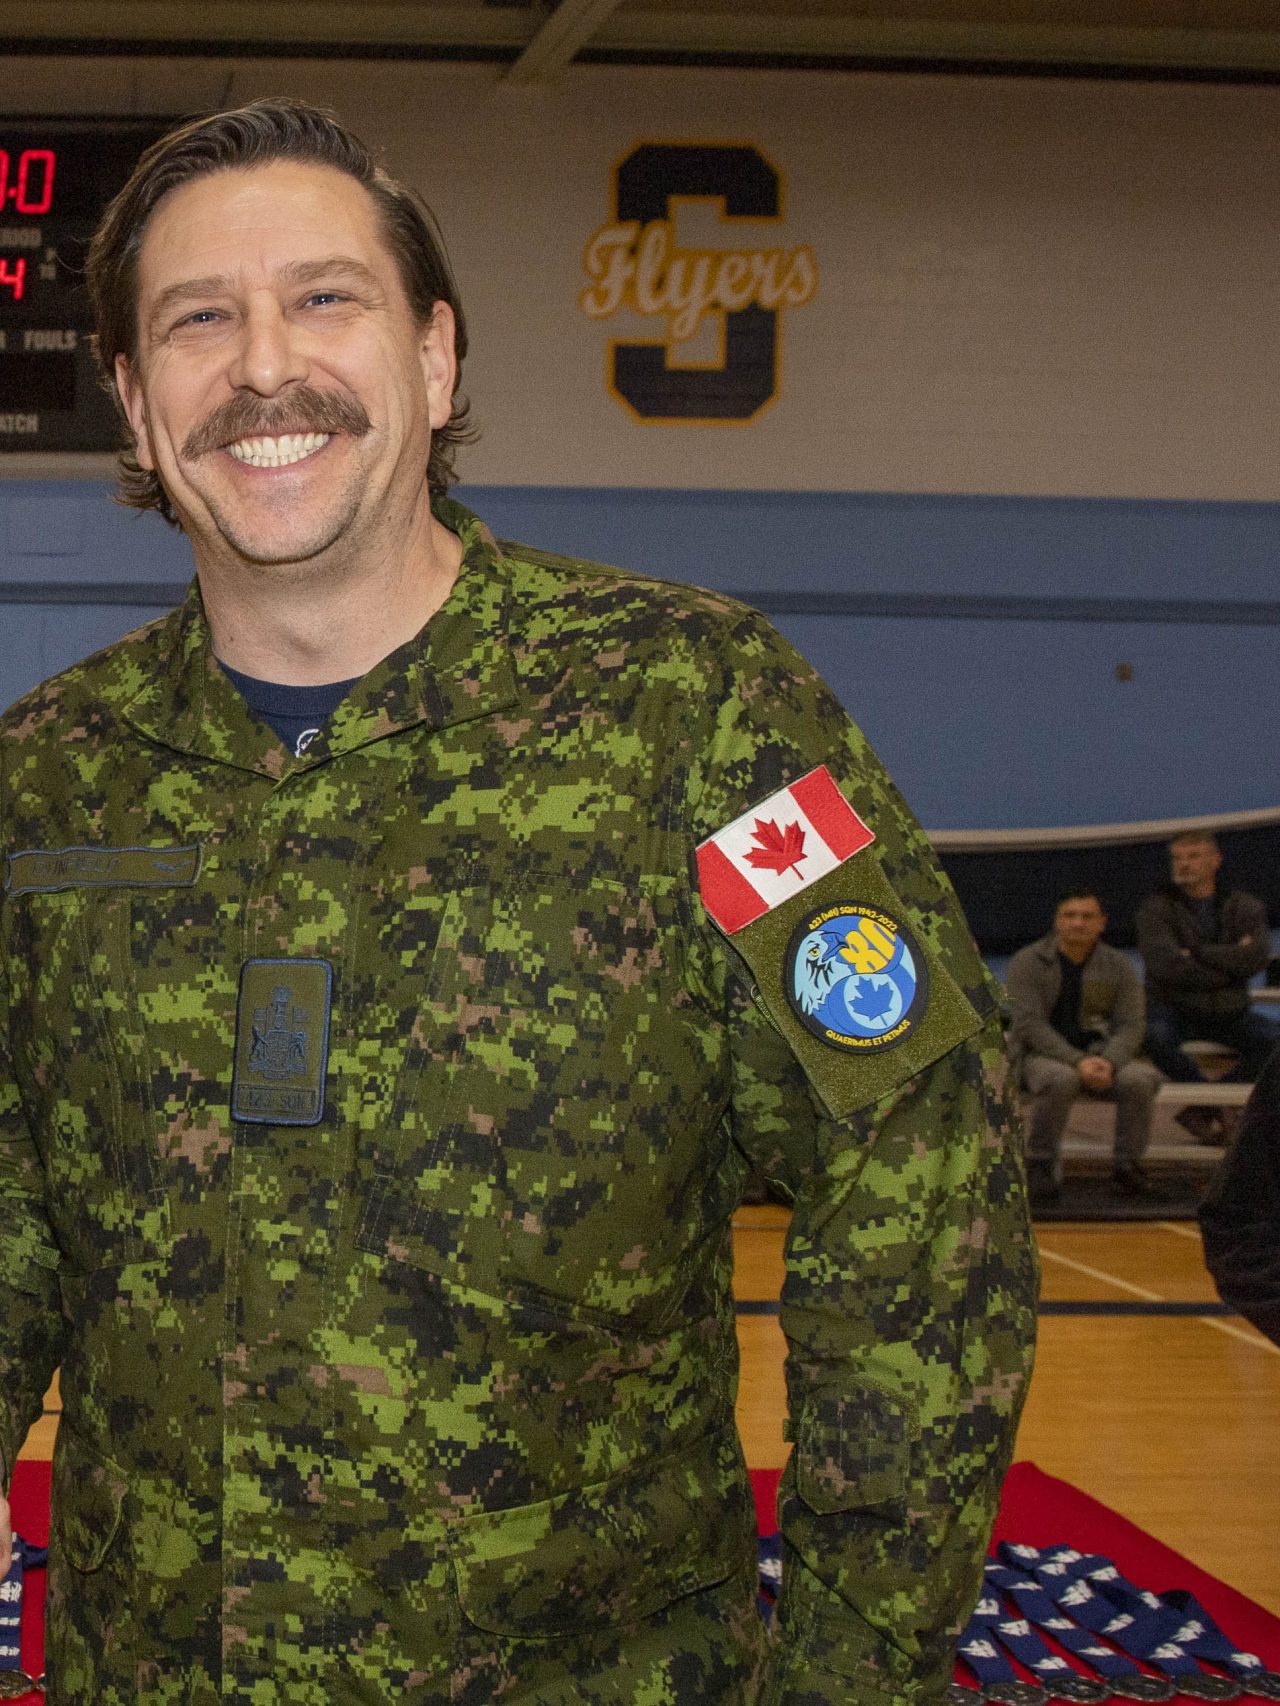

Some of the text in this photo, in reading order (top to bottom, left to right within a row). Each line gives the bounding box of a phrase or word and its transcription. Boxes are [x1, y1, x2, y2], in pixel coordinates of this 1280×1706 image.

[579, 218, 819, 343] Flyers
[24, 329, 78, 350] FOULS
[872, 1036, 883, 1046] ET
